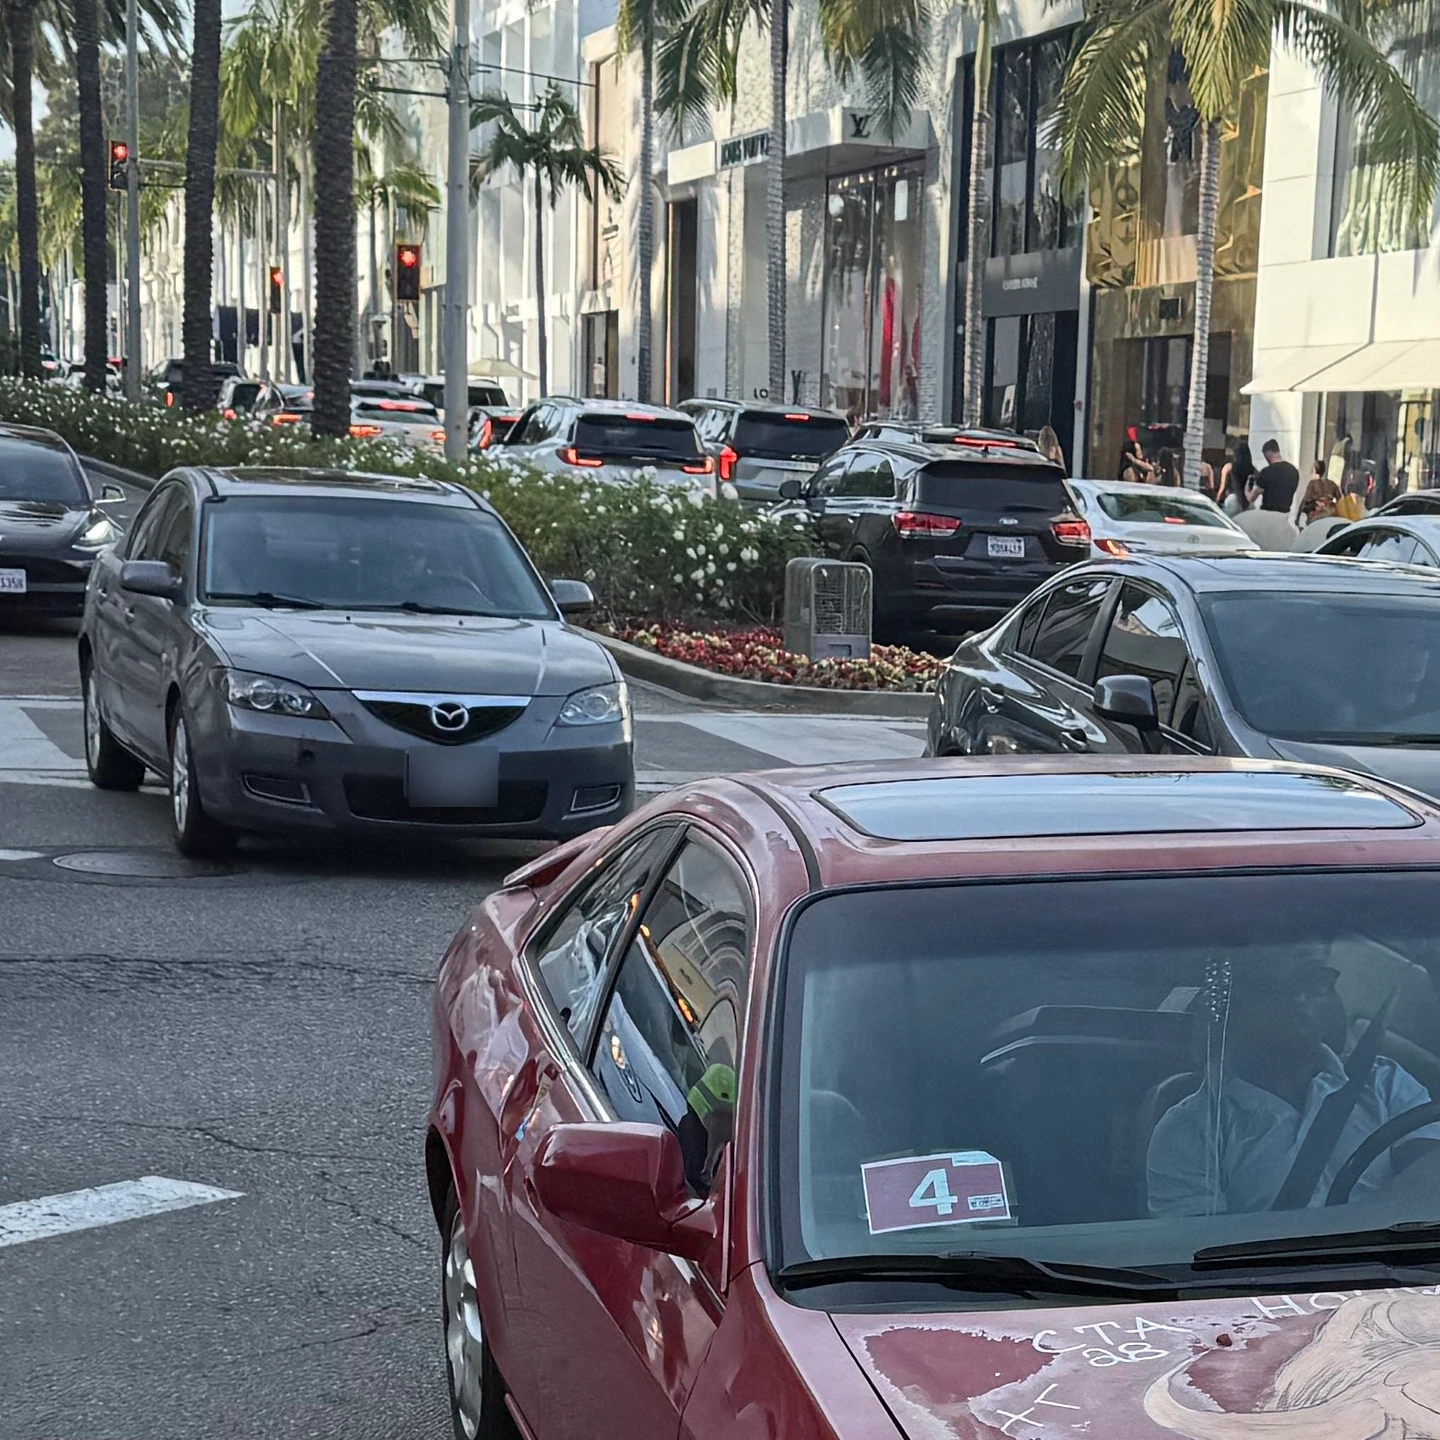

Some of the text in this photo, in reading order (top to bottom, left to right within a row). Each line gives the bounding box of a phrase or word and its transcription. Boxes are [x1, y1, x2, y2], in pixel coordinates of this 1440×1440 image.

[908, 1168, 959, 1216] 4
[1032, 1316, 1194, 1354] CTA
[1082, 1342, 1170, 1367] 28
